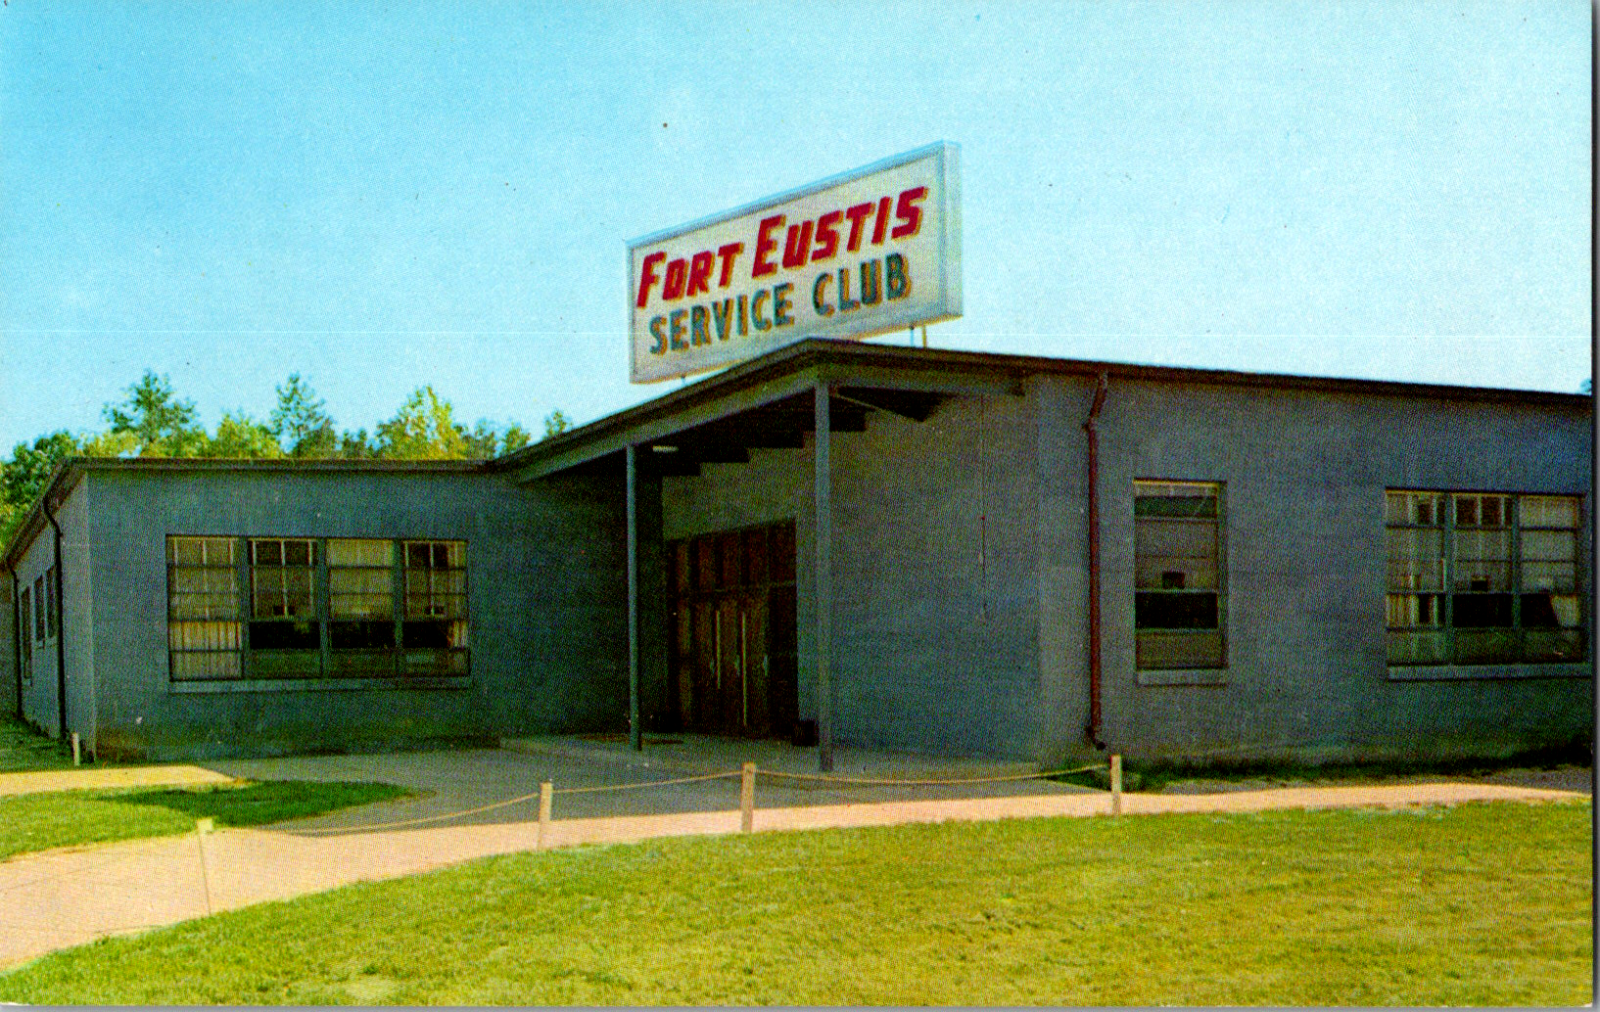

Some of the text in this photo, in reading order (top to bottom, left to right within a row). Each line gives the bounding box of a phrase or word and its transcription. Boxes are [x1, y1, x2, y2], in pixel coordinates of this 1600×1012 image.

[636, 186, 928, 308] FORT EUSTIS
[649, 253, 911, 355] SERVICE CLUB
